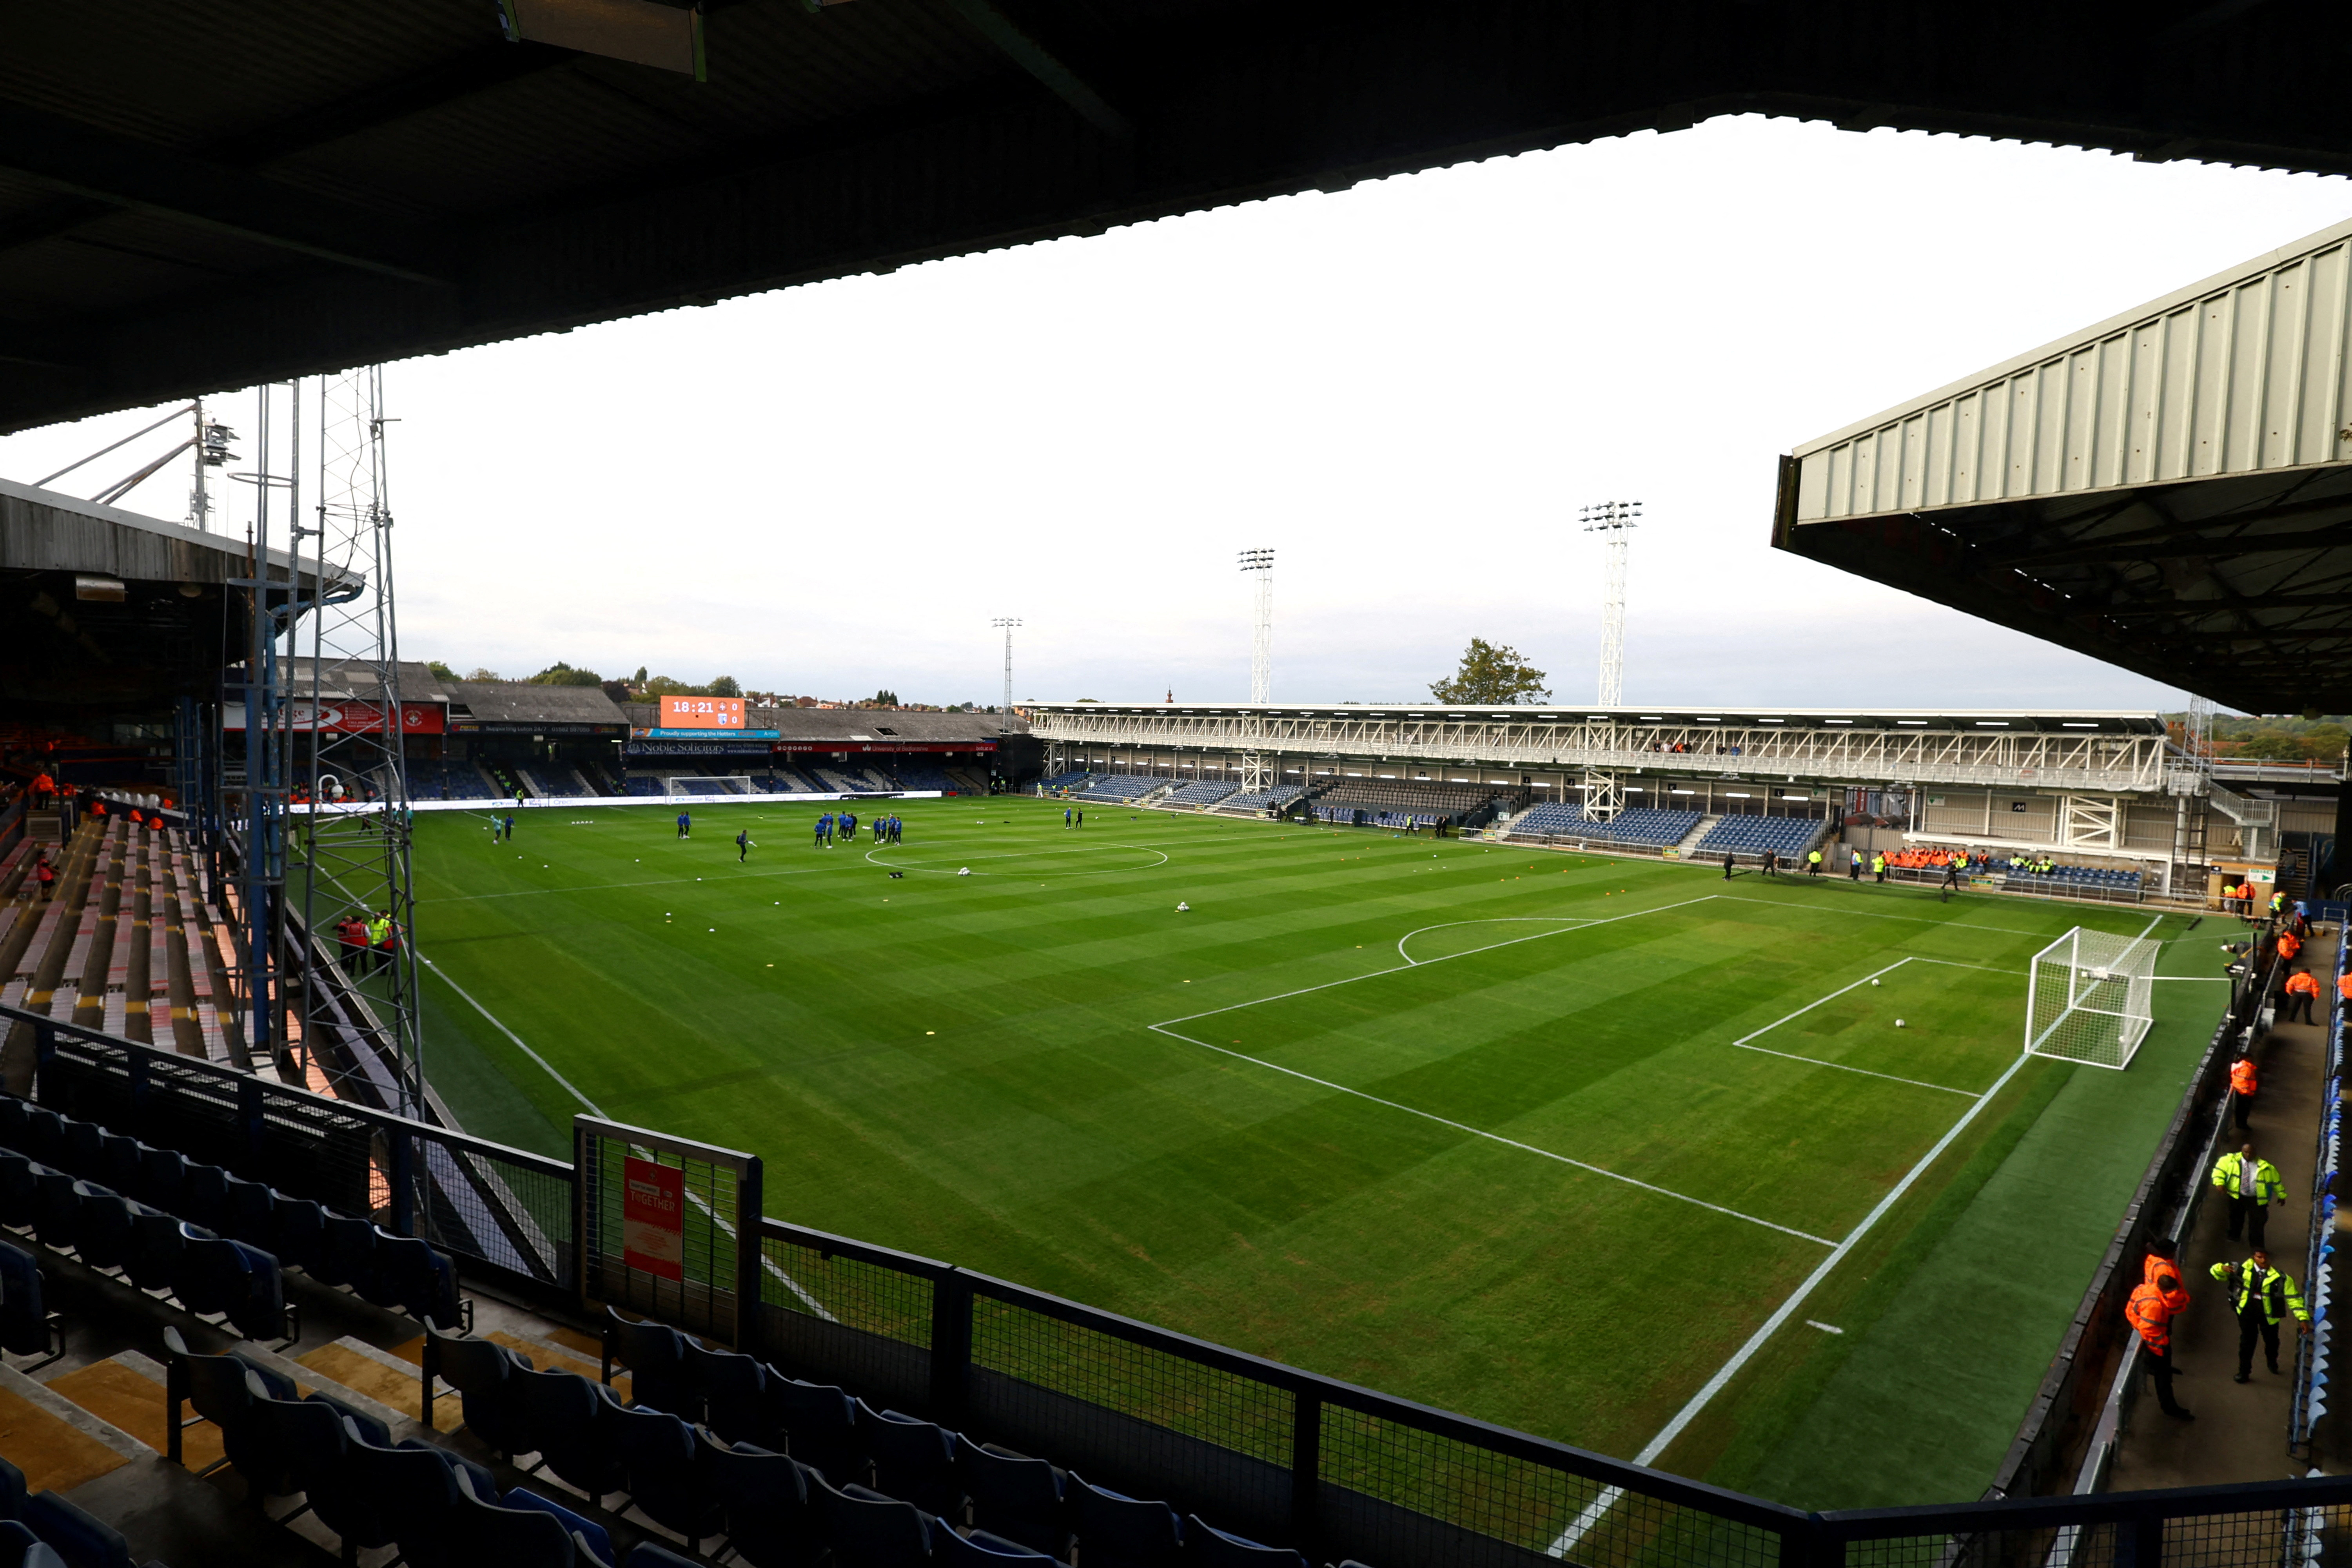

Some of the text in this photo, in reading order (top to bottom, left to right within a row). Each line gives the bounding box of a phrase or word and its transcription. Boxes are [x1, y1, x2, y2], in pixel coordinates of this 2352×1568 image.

[673, 701, 713, 713] 18:21
[642, 742, 675, 752] Noble
[677, 743, 724, 752] Solicitors
[630, 1191, 675, 1212] TOGETHER
